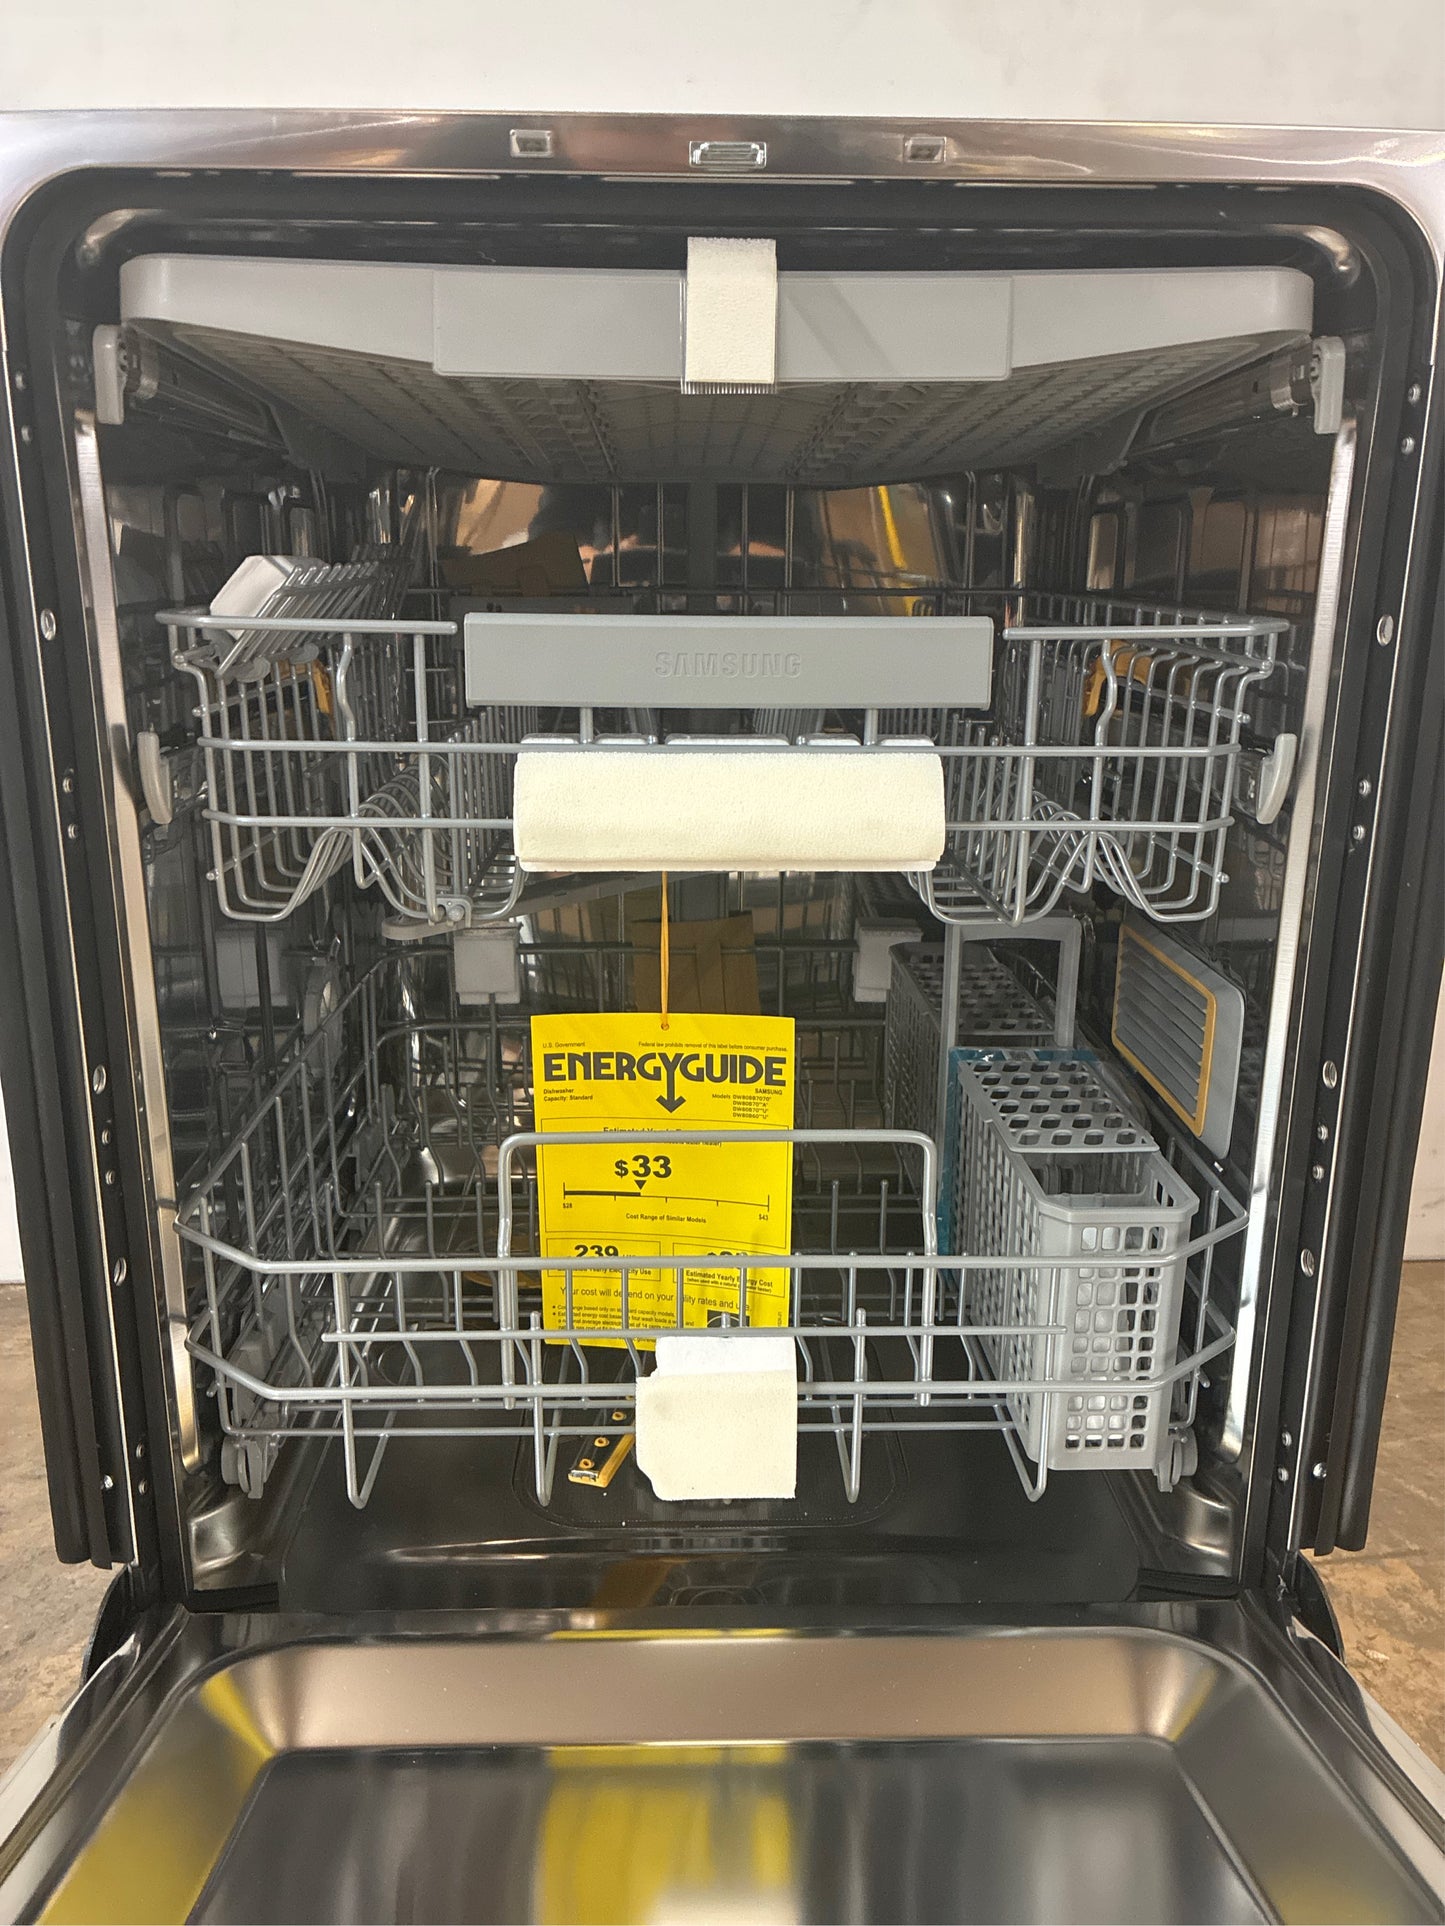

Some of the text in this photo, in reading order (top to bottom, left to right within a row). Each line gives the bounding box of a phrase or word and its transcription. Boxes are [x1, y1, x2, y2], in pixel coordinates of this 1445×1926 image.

[655, 651, 801, 678] SAMSUNG
[543, 1052, 787, 1087] ENERGYGUIDE
[754, 1088, 783, 1096] SAMSUNG
[614, 1154, 672, 1179] $33
[625, 1212, 639, 1220] Cost
[640, 1213, 658, 1222] Range
[666, 1214, 685, 1222] Similar
[686, 1215, 706, 1224] Models
[686, 1270, 716, 1279] Estimated
[716, 1273, 735, 1282] Yearly
[758, 1279, 773, 1288] Cost
[560, 1286, 579, 1295] Yur
[581, 1288, 597, 1296] cost
[598, 1289, 612, 1297] will
[613, 1289, 643, 1299] deend
[644, 1292, 655, 1300] on
[656, 1293, 674, 1302] your
[697, 1297, 717, 1307] rates
[719, 1299, 733, 1309] and
